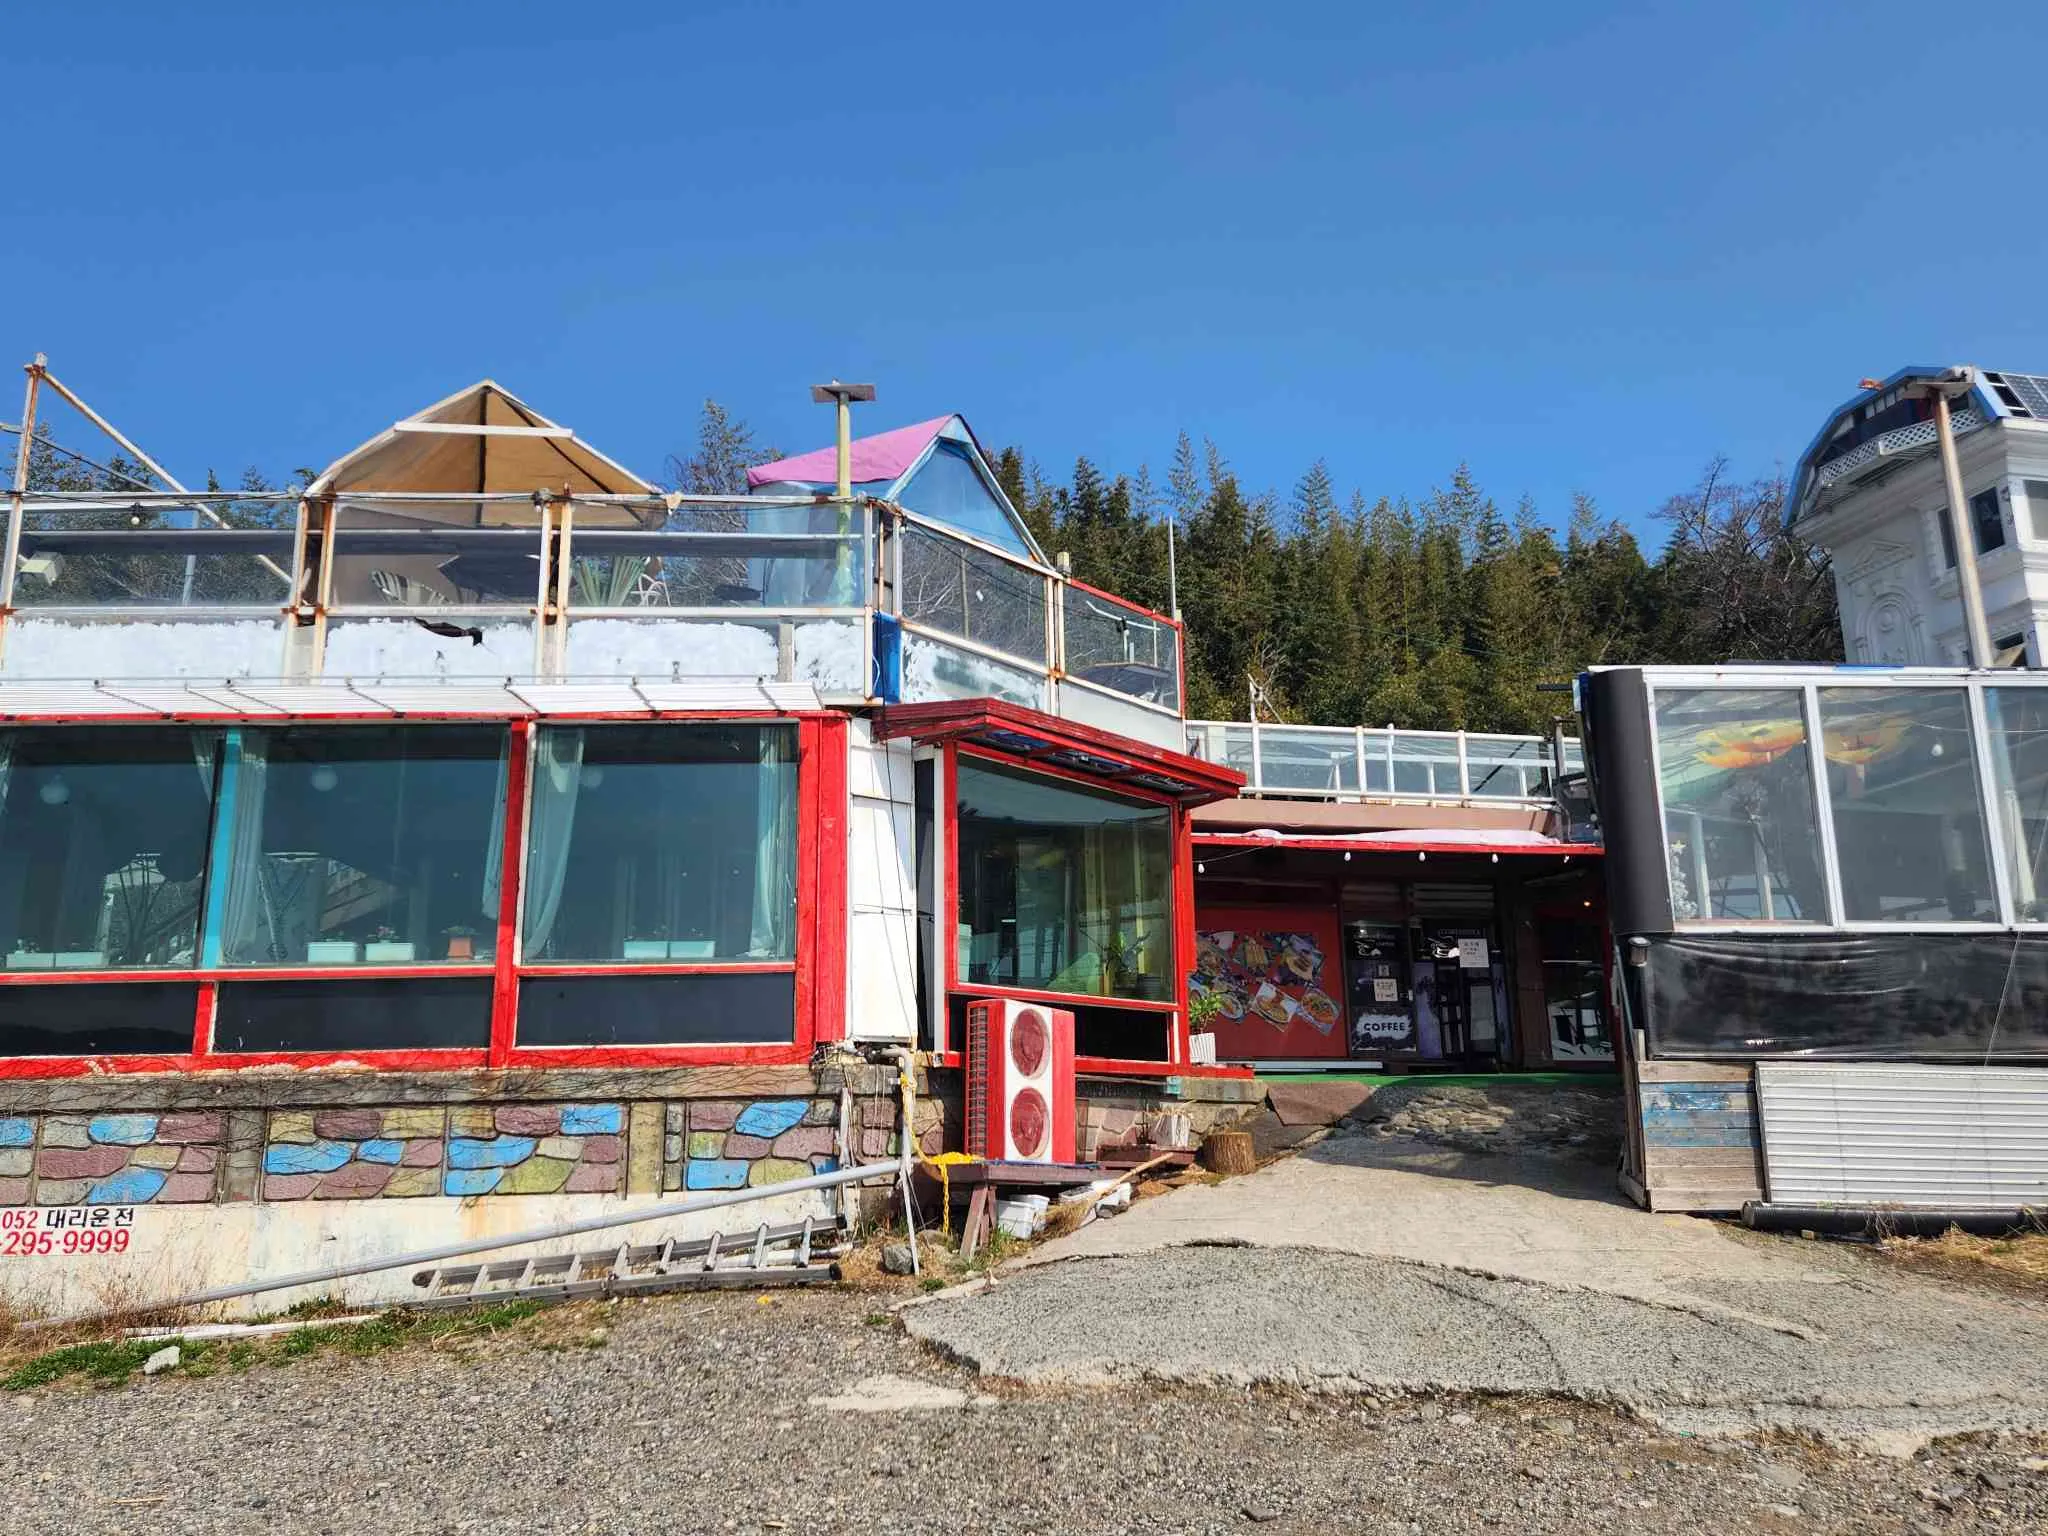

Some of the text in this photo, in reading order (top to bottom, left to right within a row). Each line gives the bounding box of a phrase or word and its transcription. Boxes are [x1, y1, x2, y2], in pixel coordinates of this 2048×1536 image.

[1363, 1022, 1405, 1031] COFFEE
[2, 1207, 135, 1229] 052 대리운전
